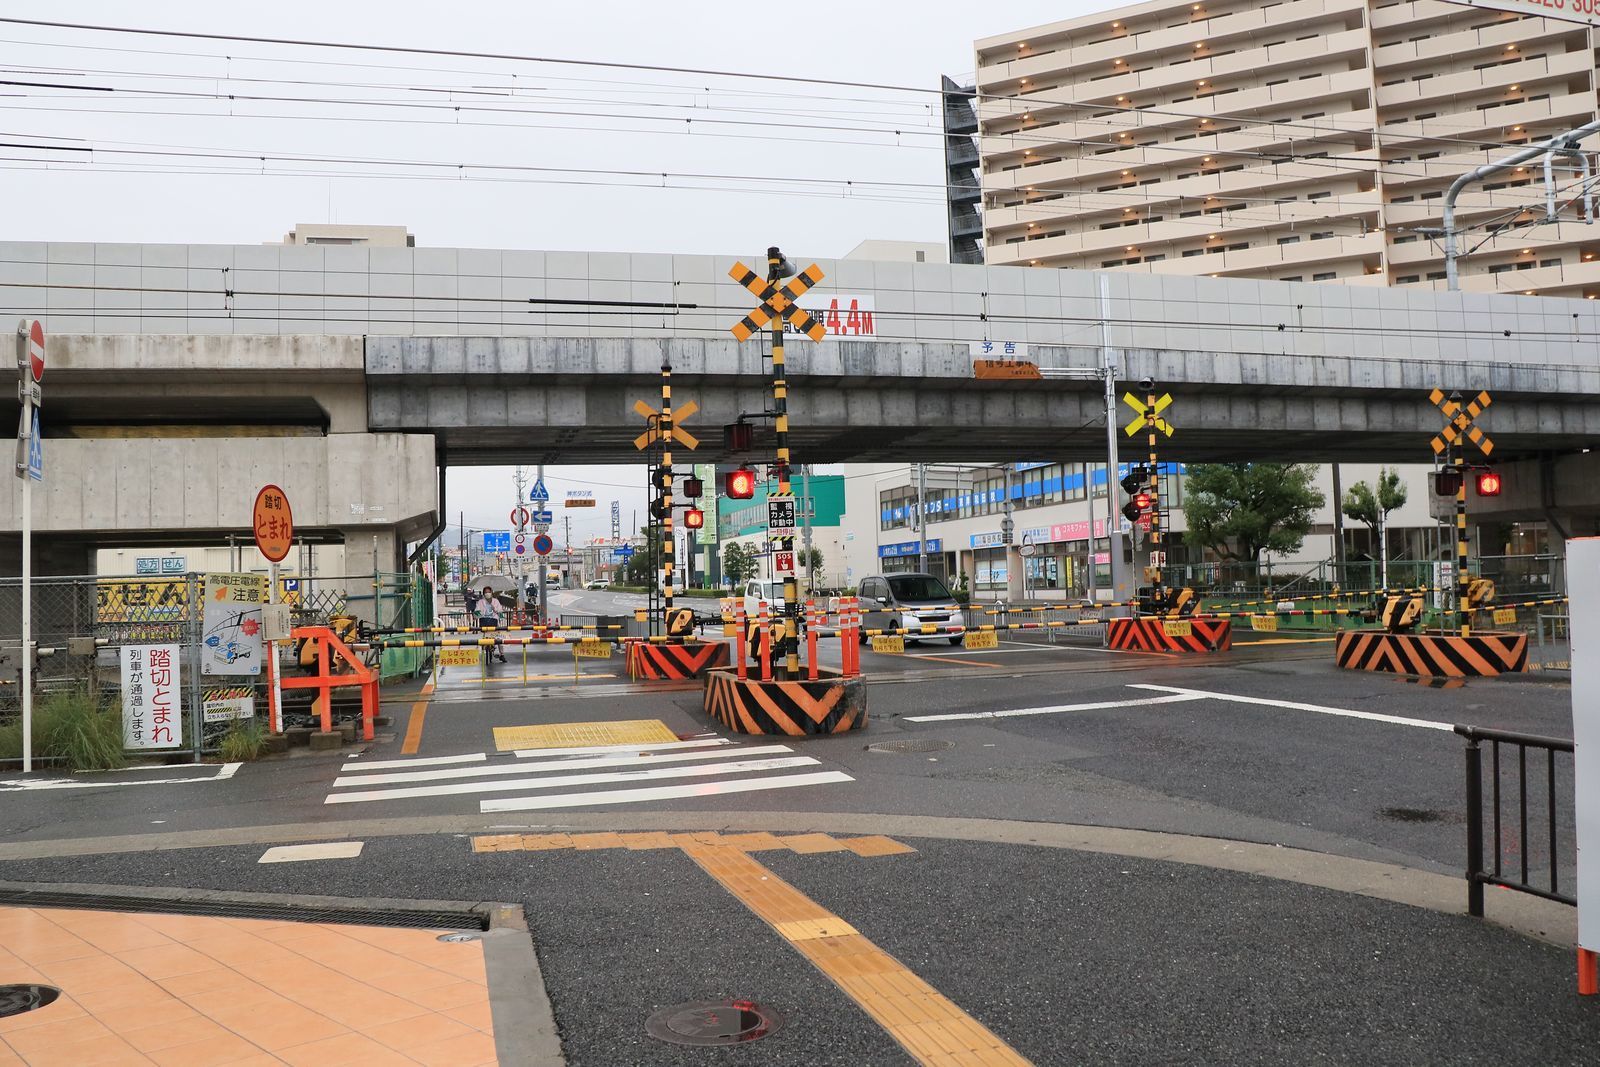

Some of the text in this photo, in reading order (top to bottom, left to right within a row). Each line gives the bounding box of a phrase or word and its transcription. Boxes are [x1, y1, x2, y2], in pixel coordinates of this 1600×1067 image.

[827, 299, 873, 335] 4.4M
[982, 341, 1016, 353] 予告
[265, 494, 281, 510] 踏切
[770, 502, 793, 511] 監視
[771, 511, 793, 520] カメラ
[257, 514, 290, 540] とまれ
[771, 519, 793, 527] 作動中
[209, 574, 261, 587] 高電圧電線
[232, 588, 260, 603] 注意
[441, 657, 479, 666] お待ち下さい
[129, 649, 144, 746] 列車が通過します。
[149, 649, 173, 743] 踏切とまれ
